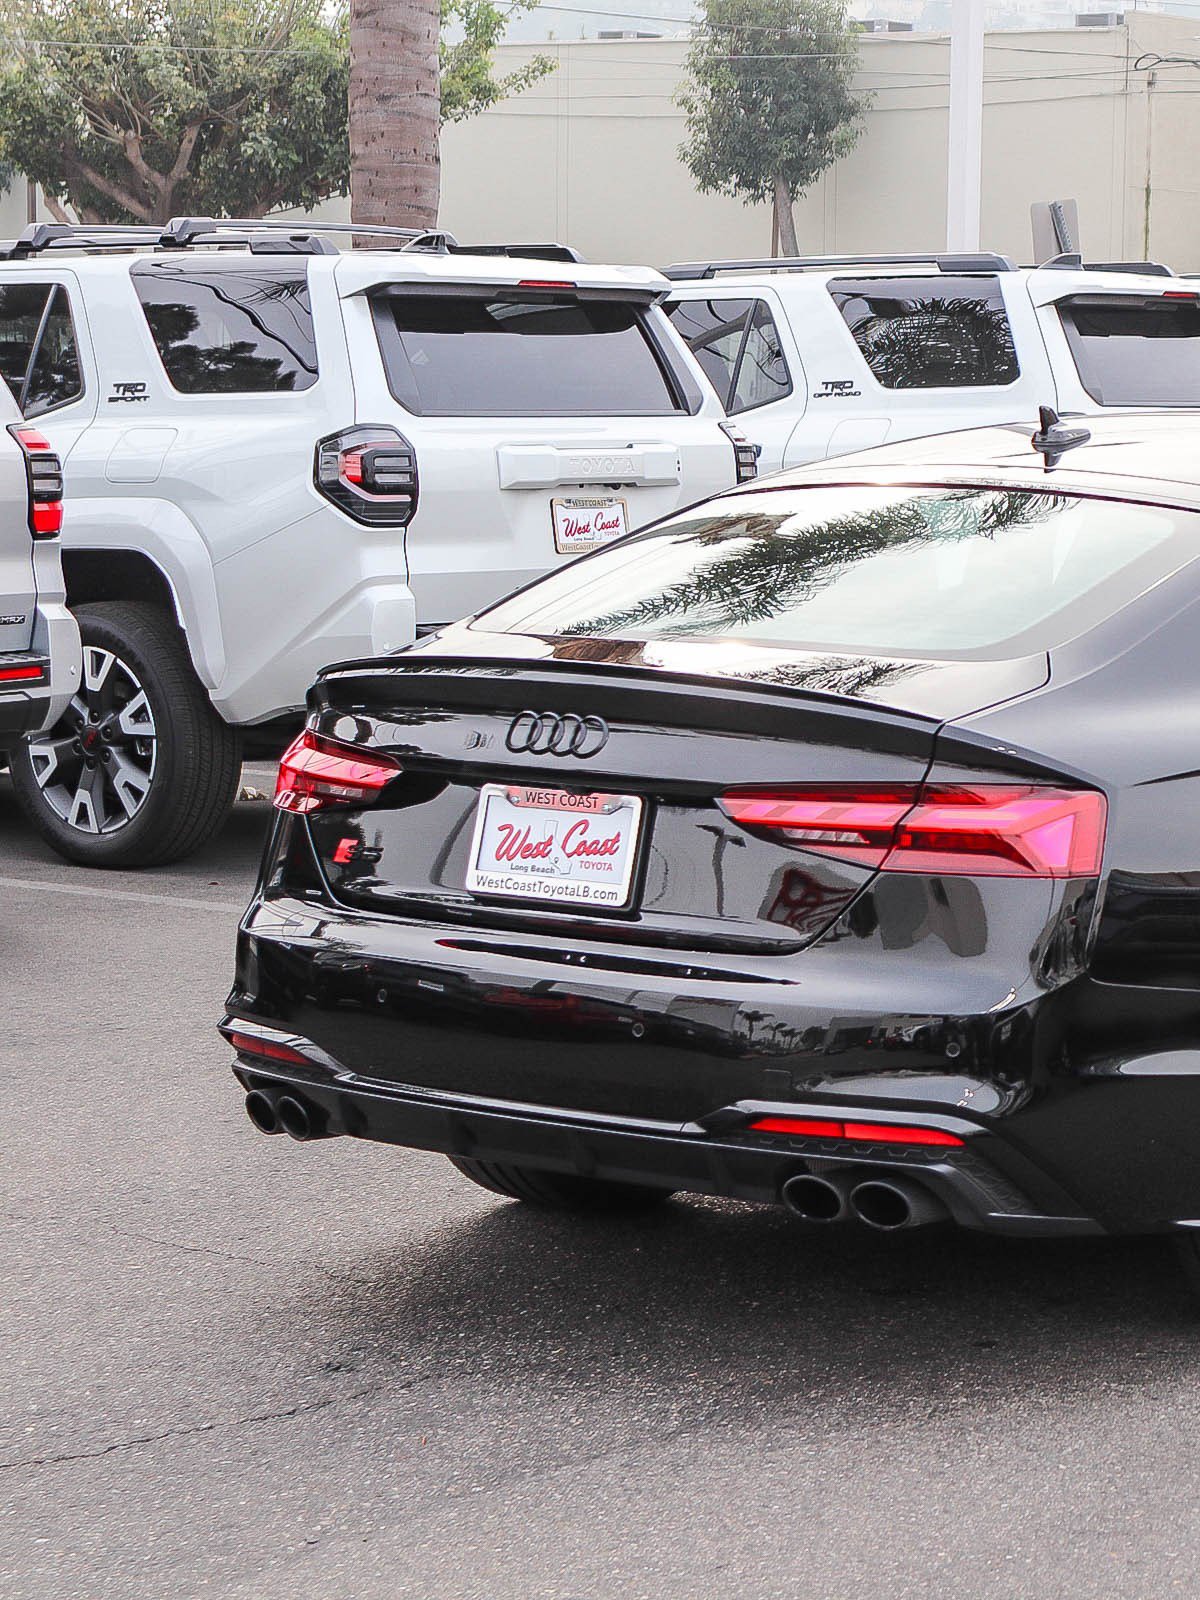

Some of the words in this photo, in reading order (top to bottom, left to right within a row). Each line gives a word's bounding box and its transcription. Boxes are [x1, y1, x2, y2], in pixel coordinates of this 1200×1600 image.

[113, 382, 146, 396] TRD
[822, 381, 853, 392] TRD
[569, 457, 636, 475] TOYOTA
[588, 499, 608, 507] COAST
[562, 518, 591, 538] West
[594, 511, 620, 532] Coast
[525, 791, 557, 805] WEST
[559, 794, 599, 809] COAST
[495, 823, 554, 861] West
[560, 819, 621, 858] Coast
[510, 862, 529, 873] Long
[530, 864, 555, 874] Beach
[579, 860, 613, 872] TOYOTA
[476, 875, 618, 901] WestCoastToyotaLB.com
